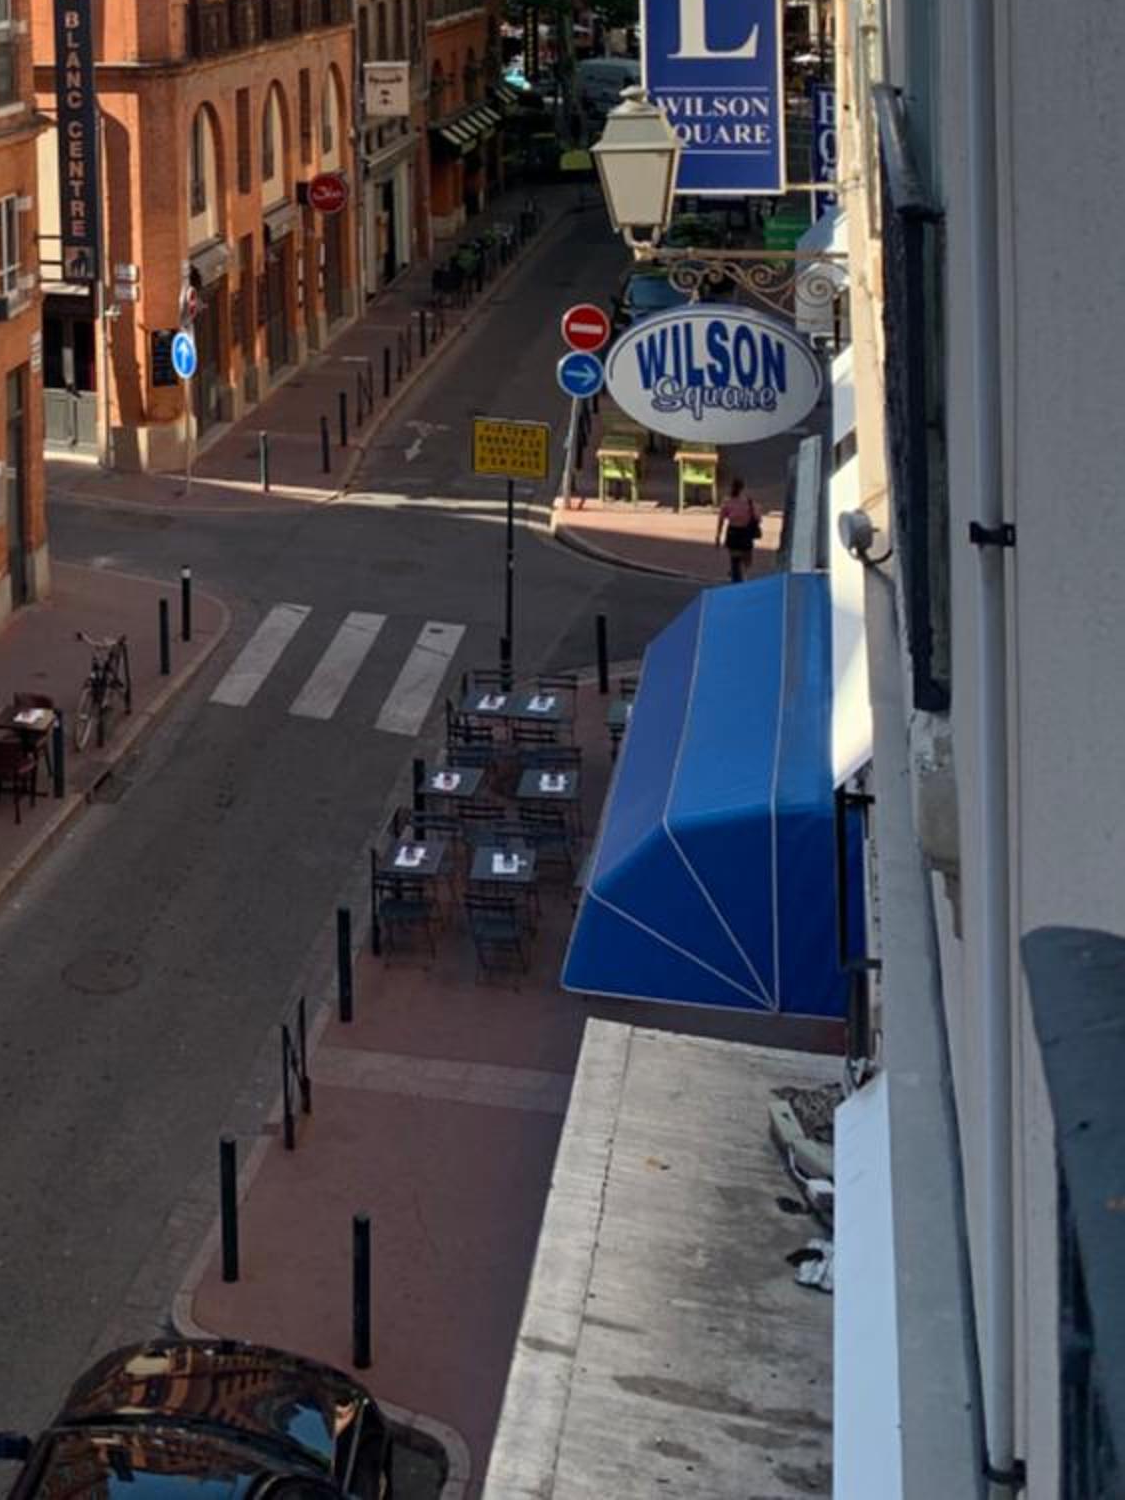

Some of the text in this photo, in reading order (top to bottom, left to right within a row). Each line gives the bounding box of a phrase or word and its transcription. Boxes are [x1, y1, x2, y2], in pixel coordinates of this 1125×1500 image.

[64, 11, 81, 108] BLANC
[656, 97, 769, 116] WILSON
[673, 123, 772, 147] QUARE
[67, 121, 86, 237] CENTRE
[635, 320, 786, 393] WILSON
[651, 374, 778, 420] Square
